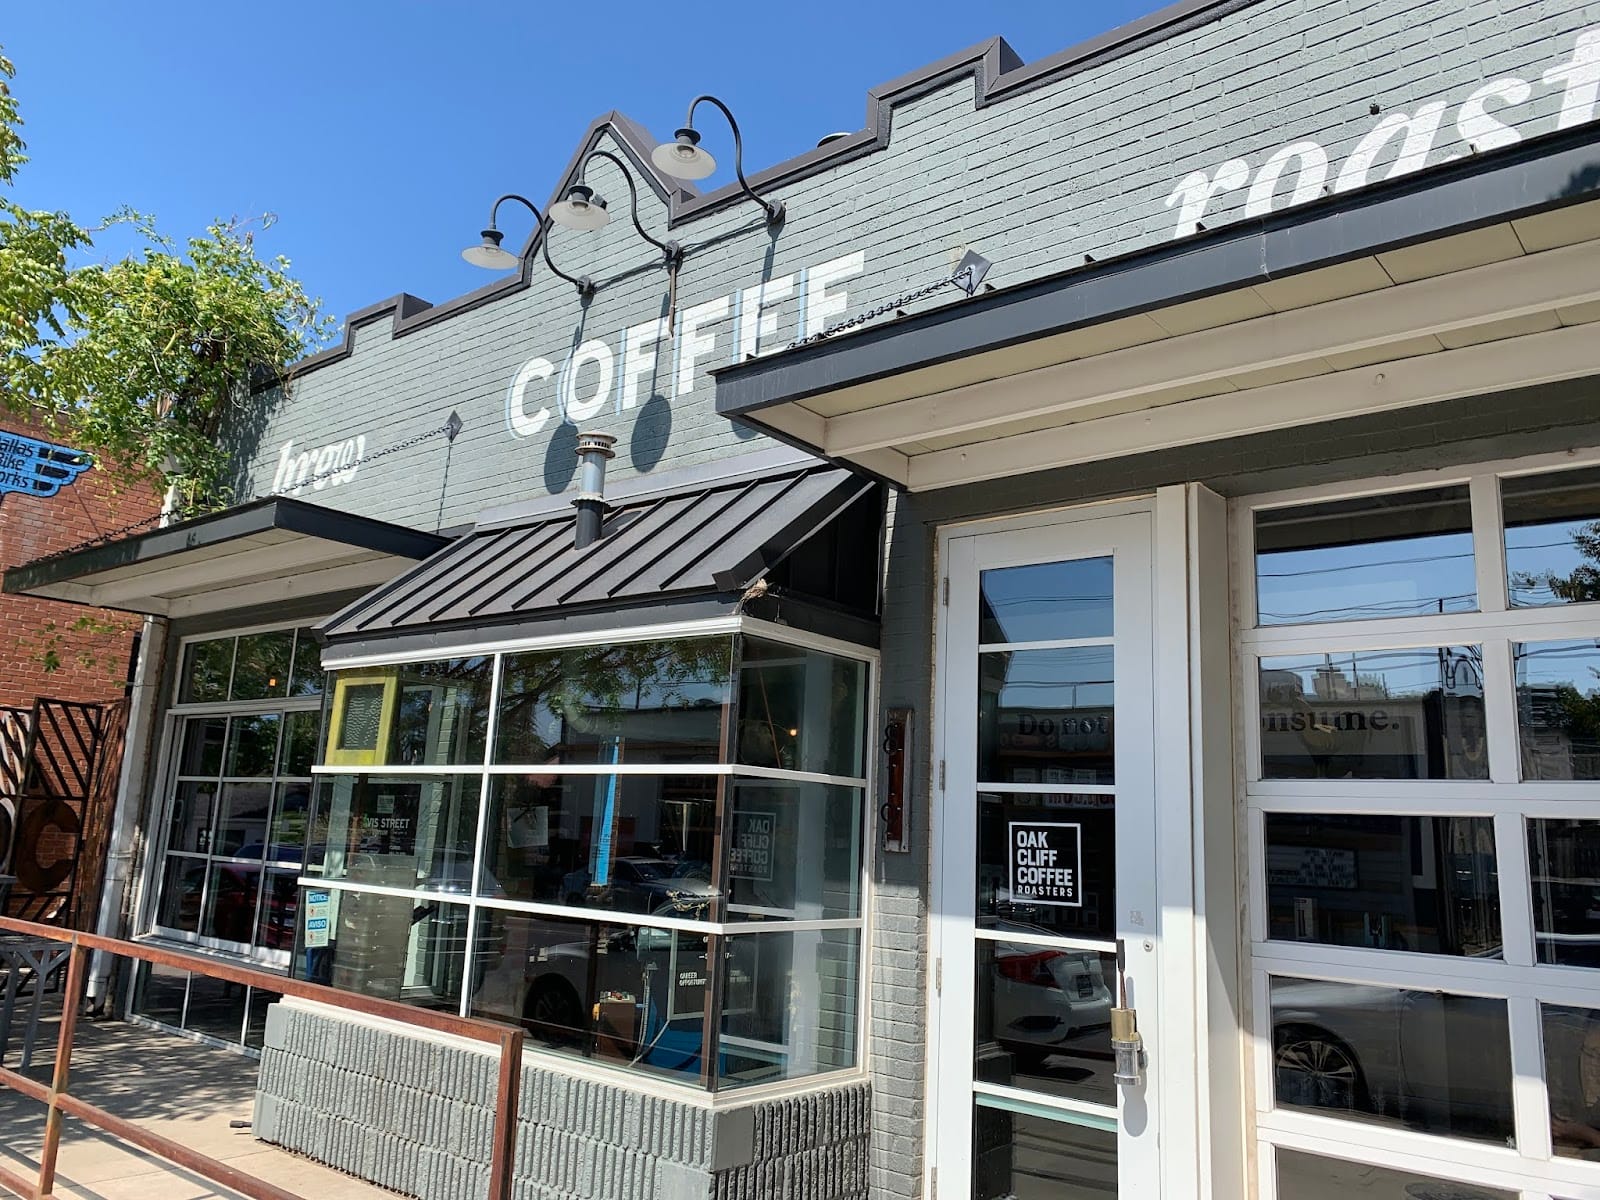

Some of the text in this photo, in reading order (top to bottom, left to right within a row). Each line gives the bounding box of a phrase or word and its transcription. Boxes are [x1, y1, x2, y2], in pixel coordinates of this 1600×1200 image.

[505, 250, 864, 440] COFFEE
[0, 438, 33, 457] allas
[0, 471, 28, 488] orks
[1017, 707, 1400, 736] Do not nsume.
[381, 818, 410, 829] STREET
[1017, 830, 1048, 849] OAK
[1017, 849, 1057, 867] CLIFF
[1017, 867, 1073, 887] COFFEE
[1017, 884, 1073, 897] ROASTERS
